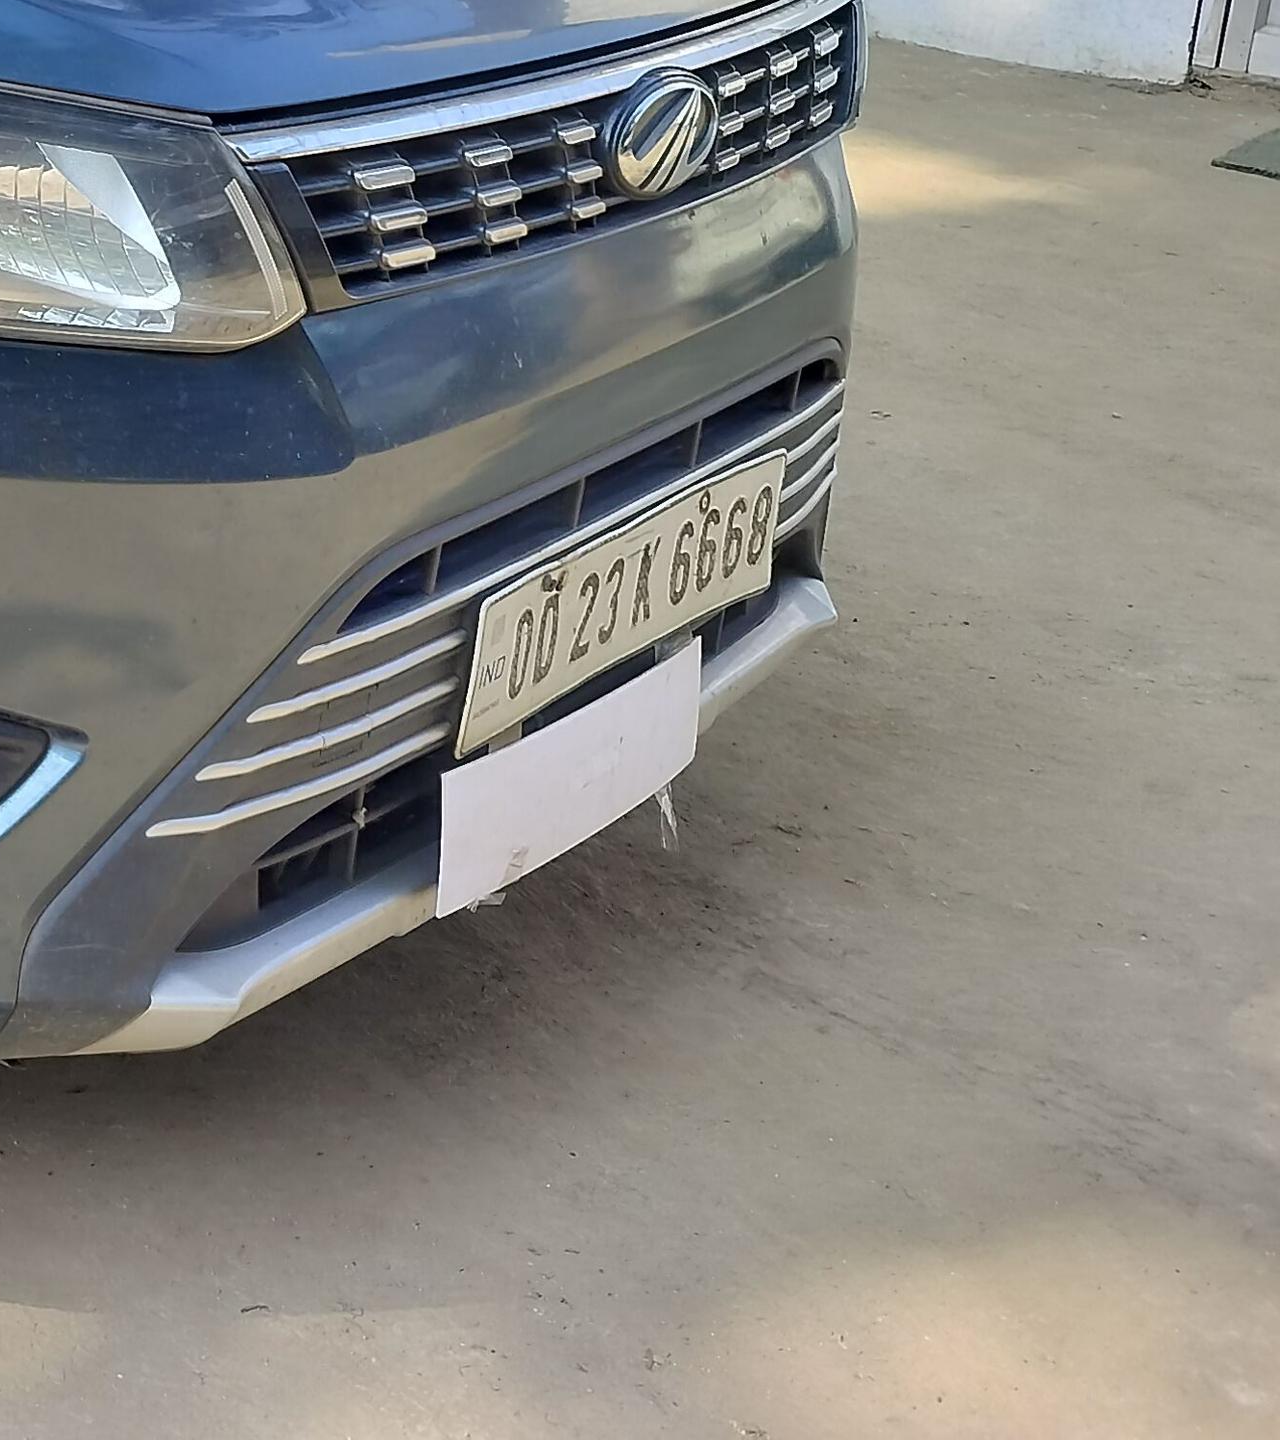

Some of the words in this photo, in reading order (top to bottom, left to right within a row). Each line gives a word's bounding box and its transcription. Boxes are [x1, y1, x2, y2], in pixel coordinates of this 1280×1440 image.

[567, 557, 626, 664] 23
[668, 484, 773, 607] 6668
[478, 655, 506, 690] IND
